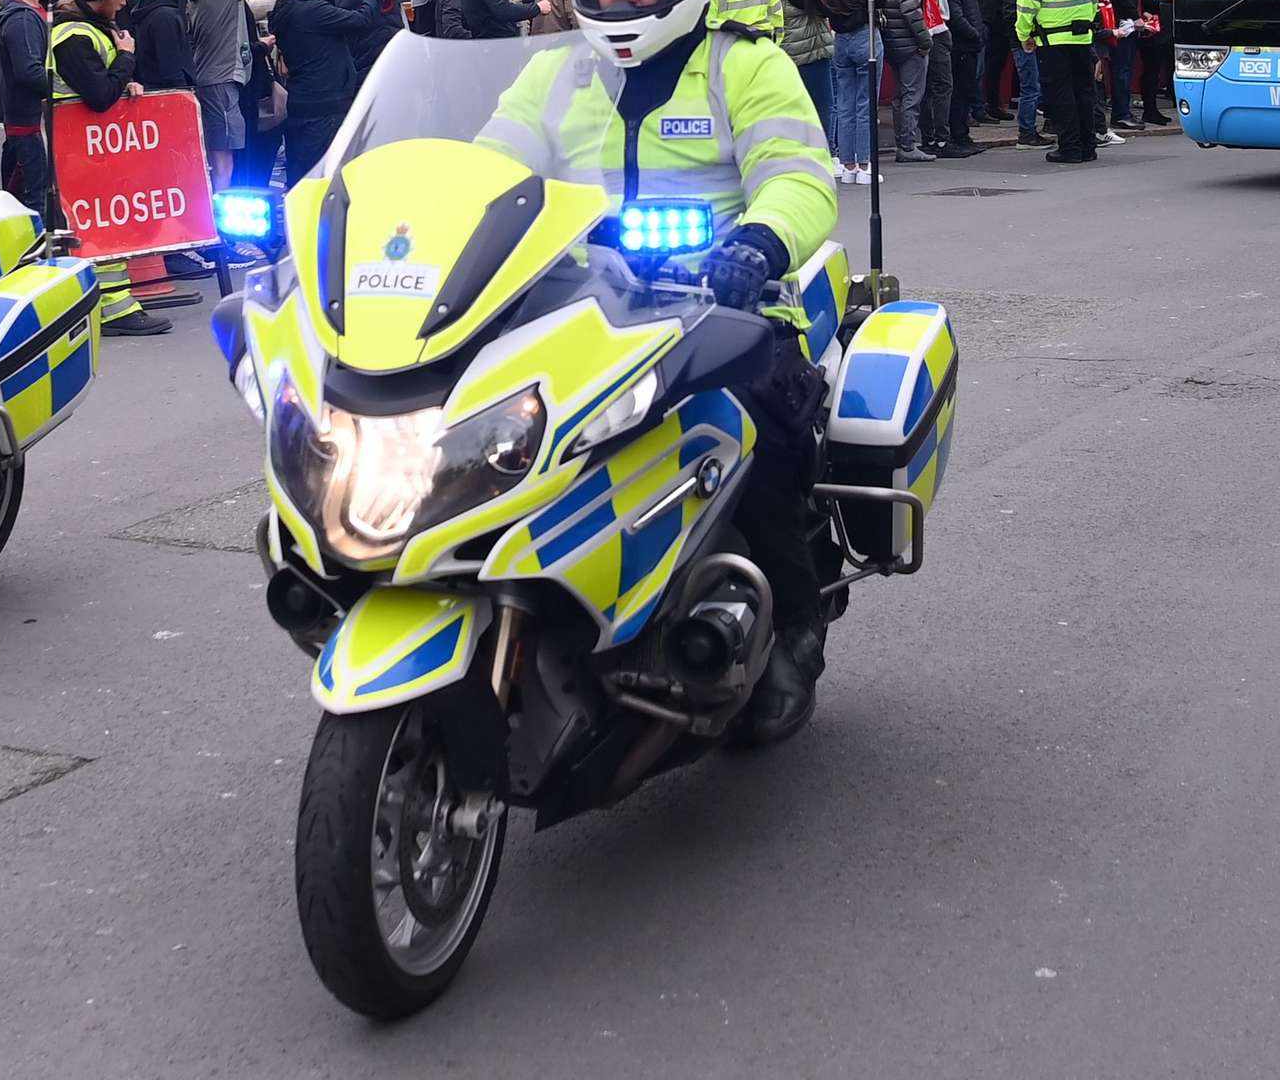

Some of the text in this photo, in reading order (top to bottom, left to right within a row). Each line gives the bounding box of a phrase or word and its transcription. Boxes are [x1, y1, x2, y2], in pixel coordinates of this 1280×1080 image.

[86, 120, 159, 155] ROAD
[663, 120, 710, 134] POLICE
[72, 187, 186, 230] CLOSED
[358, 274, 424, 290] POLICE
